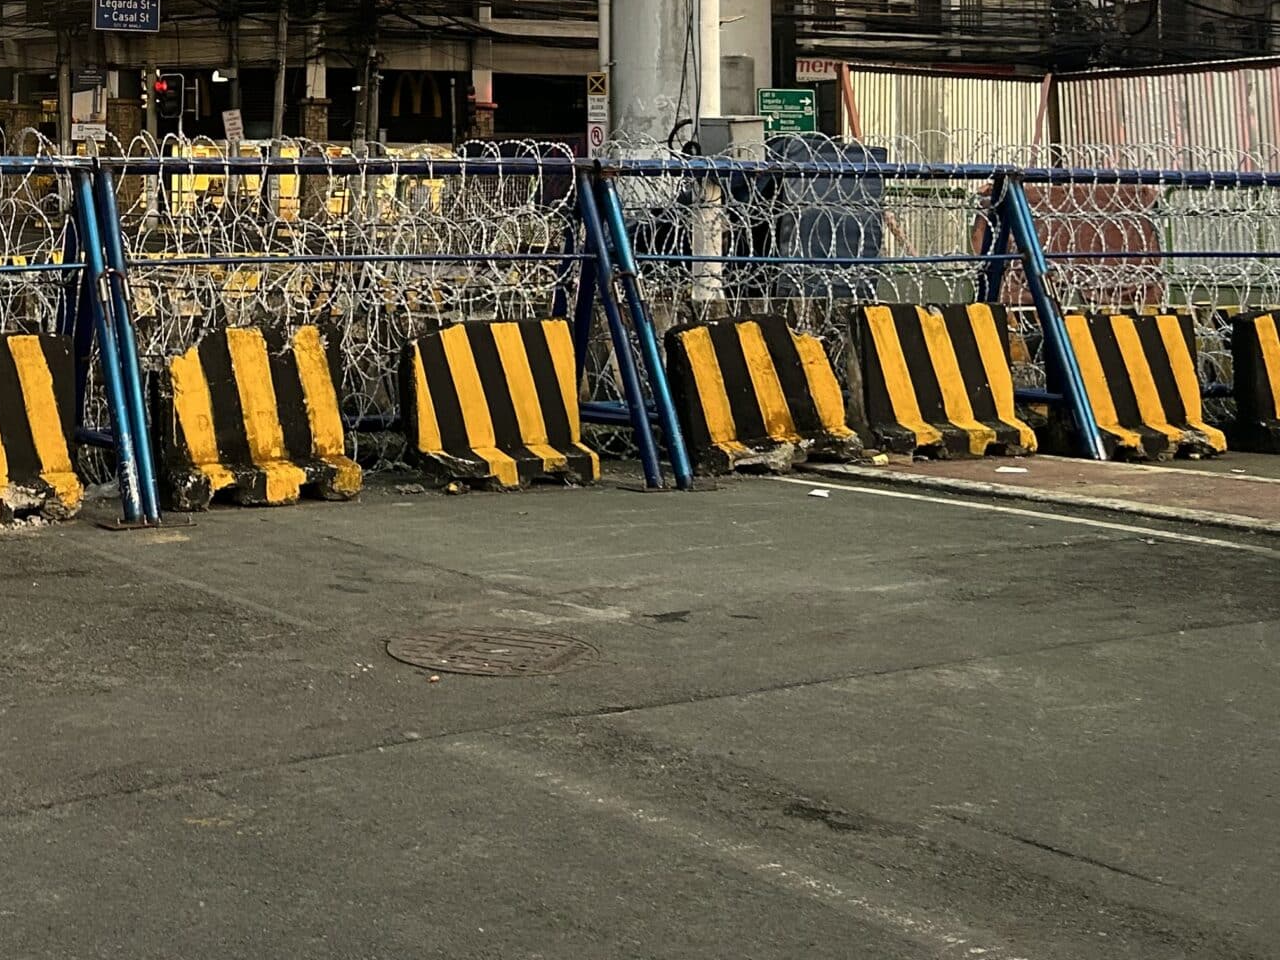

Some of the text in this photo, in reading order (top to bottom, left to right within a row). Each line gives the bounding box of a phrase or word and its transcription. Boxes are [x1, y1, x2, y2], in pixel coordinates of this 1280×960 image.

[140, 0, 150, 10] St
[112, 11, 150, 23] Casal St
